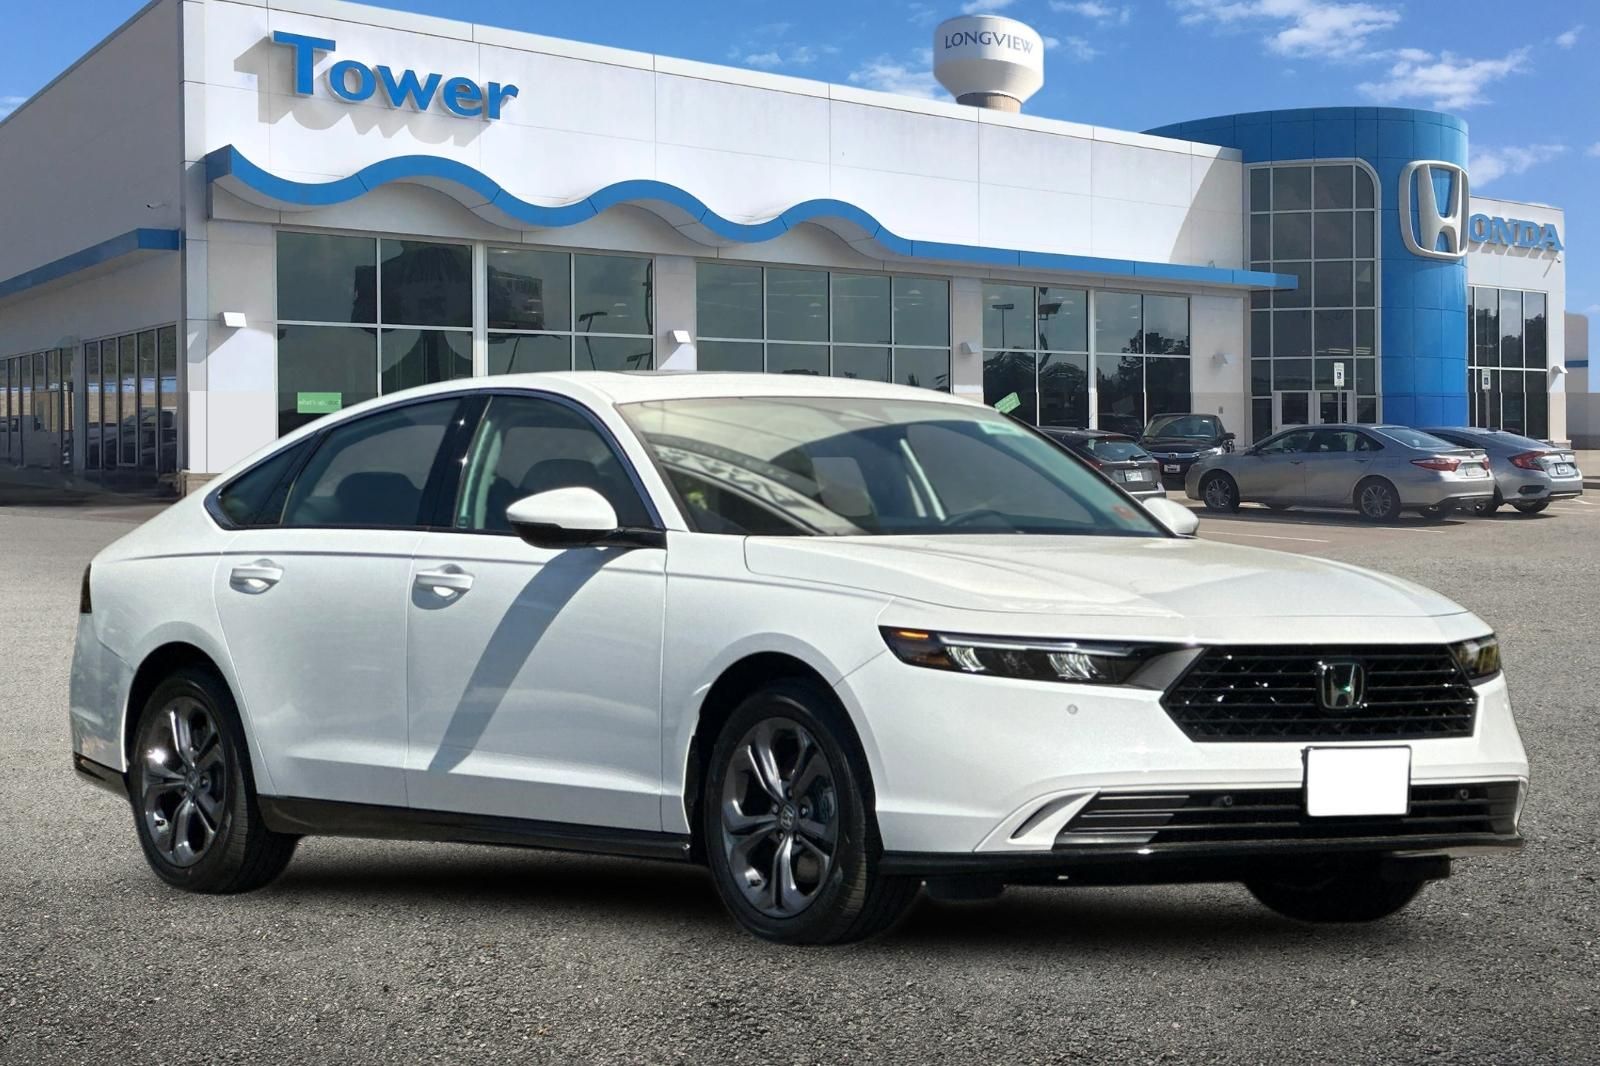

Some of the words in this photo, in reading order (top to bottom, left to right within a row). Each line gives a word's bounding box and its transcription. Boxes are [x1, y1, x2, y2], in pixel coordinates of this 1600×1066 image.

[945, 31, 1034, 54] LONGVIEW
[273, 30, 519, 120] Tower
[1470, 213, 1564, 251] ONDA
